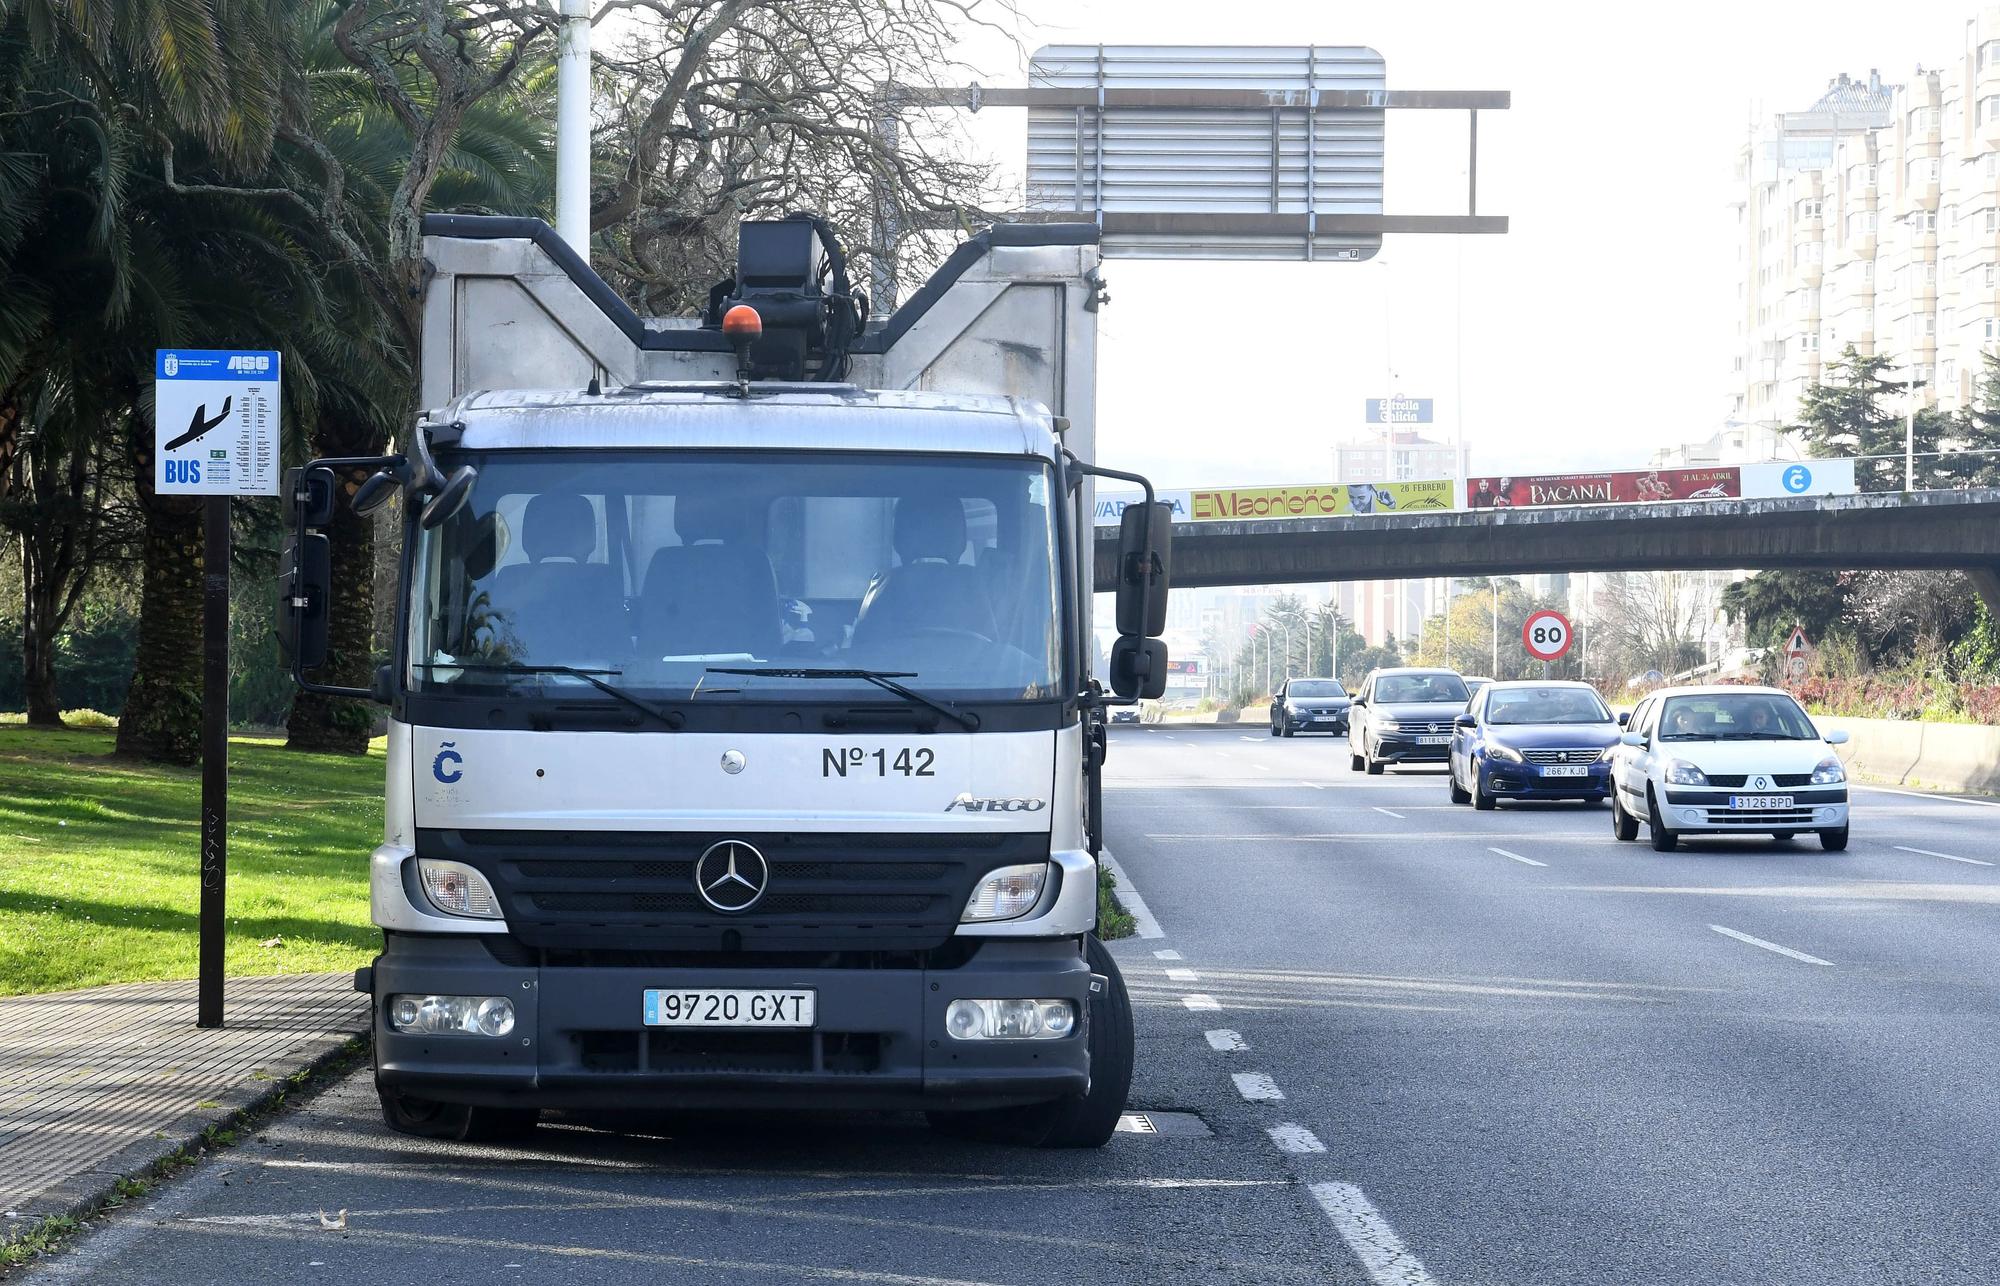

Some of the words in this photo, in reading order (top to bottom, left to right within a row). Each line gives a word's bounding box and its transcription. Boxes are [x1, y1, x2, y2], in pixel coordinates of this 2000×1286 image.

[1380, 410, 1417, 422] Glicia
[165, 460, 200, 483] BUS
[1712, 471, 1732, 480] ABRIL
[1400, 484, 1409, 492] 26
[1413, 483, 1446, 491] FEBRERO
[1530, 481, 1620, 504] BACANAL
[1534, 627, 1562, 643] 80
[872, 748, 935, 776] 142
[1546, 767, 1567, 776] 2667
[1570, 767, 1586, 775] KJD
[1738, 797, 1767, 808] 3126
[1770, 797, 1792, 808] BPD
[665, 994, 738, 1021] 9720
[751, 995, 805, 1021] GXT
